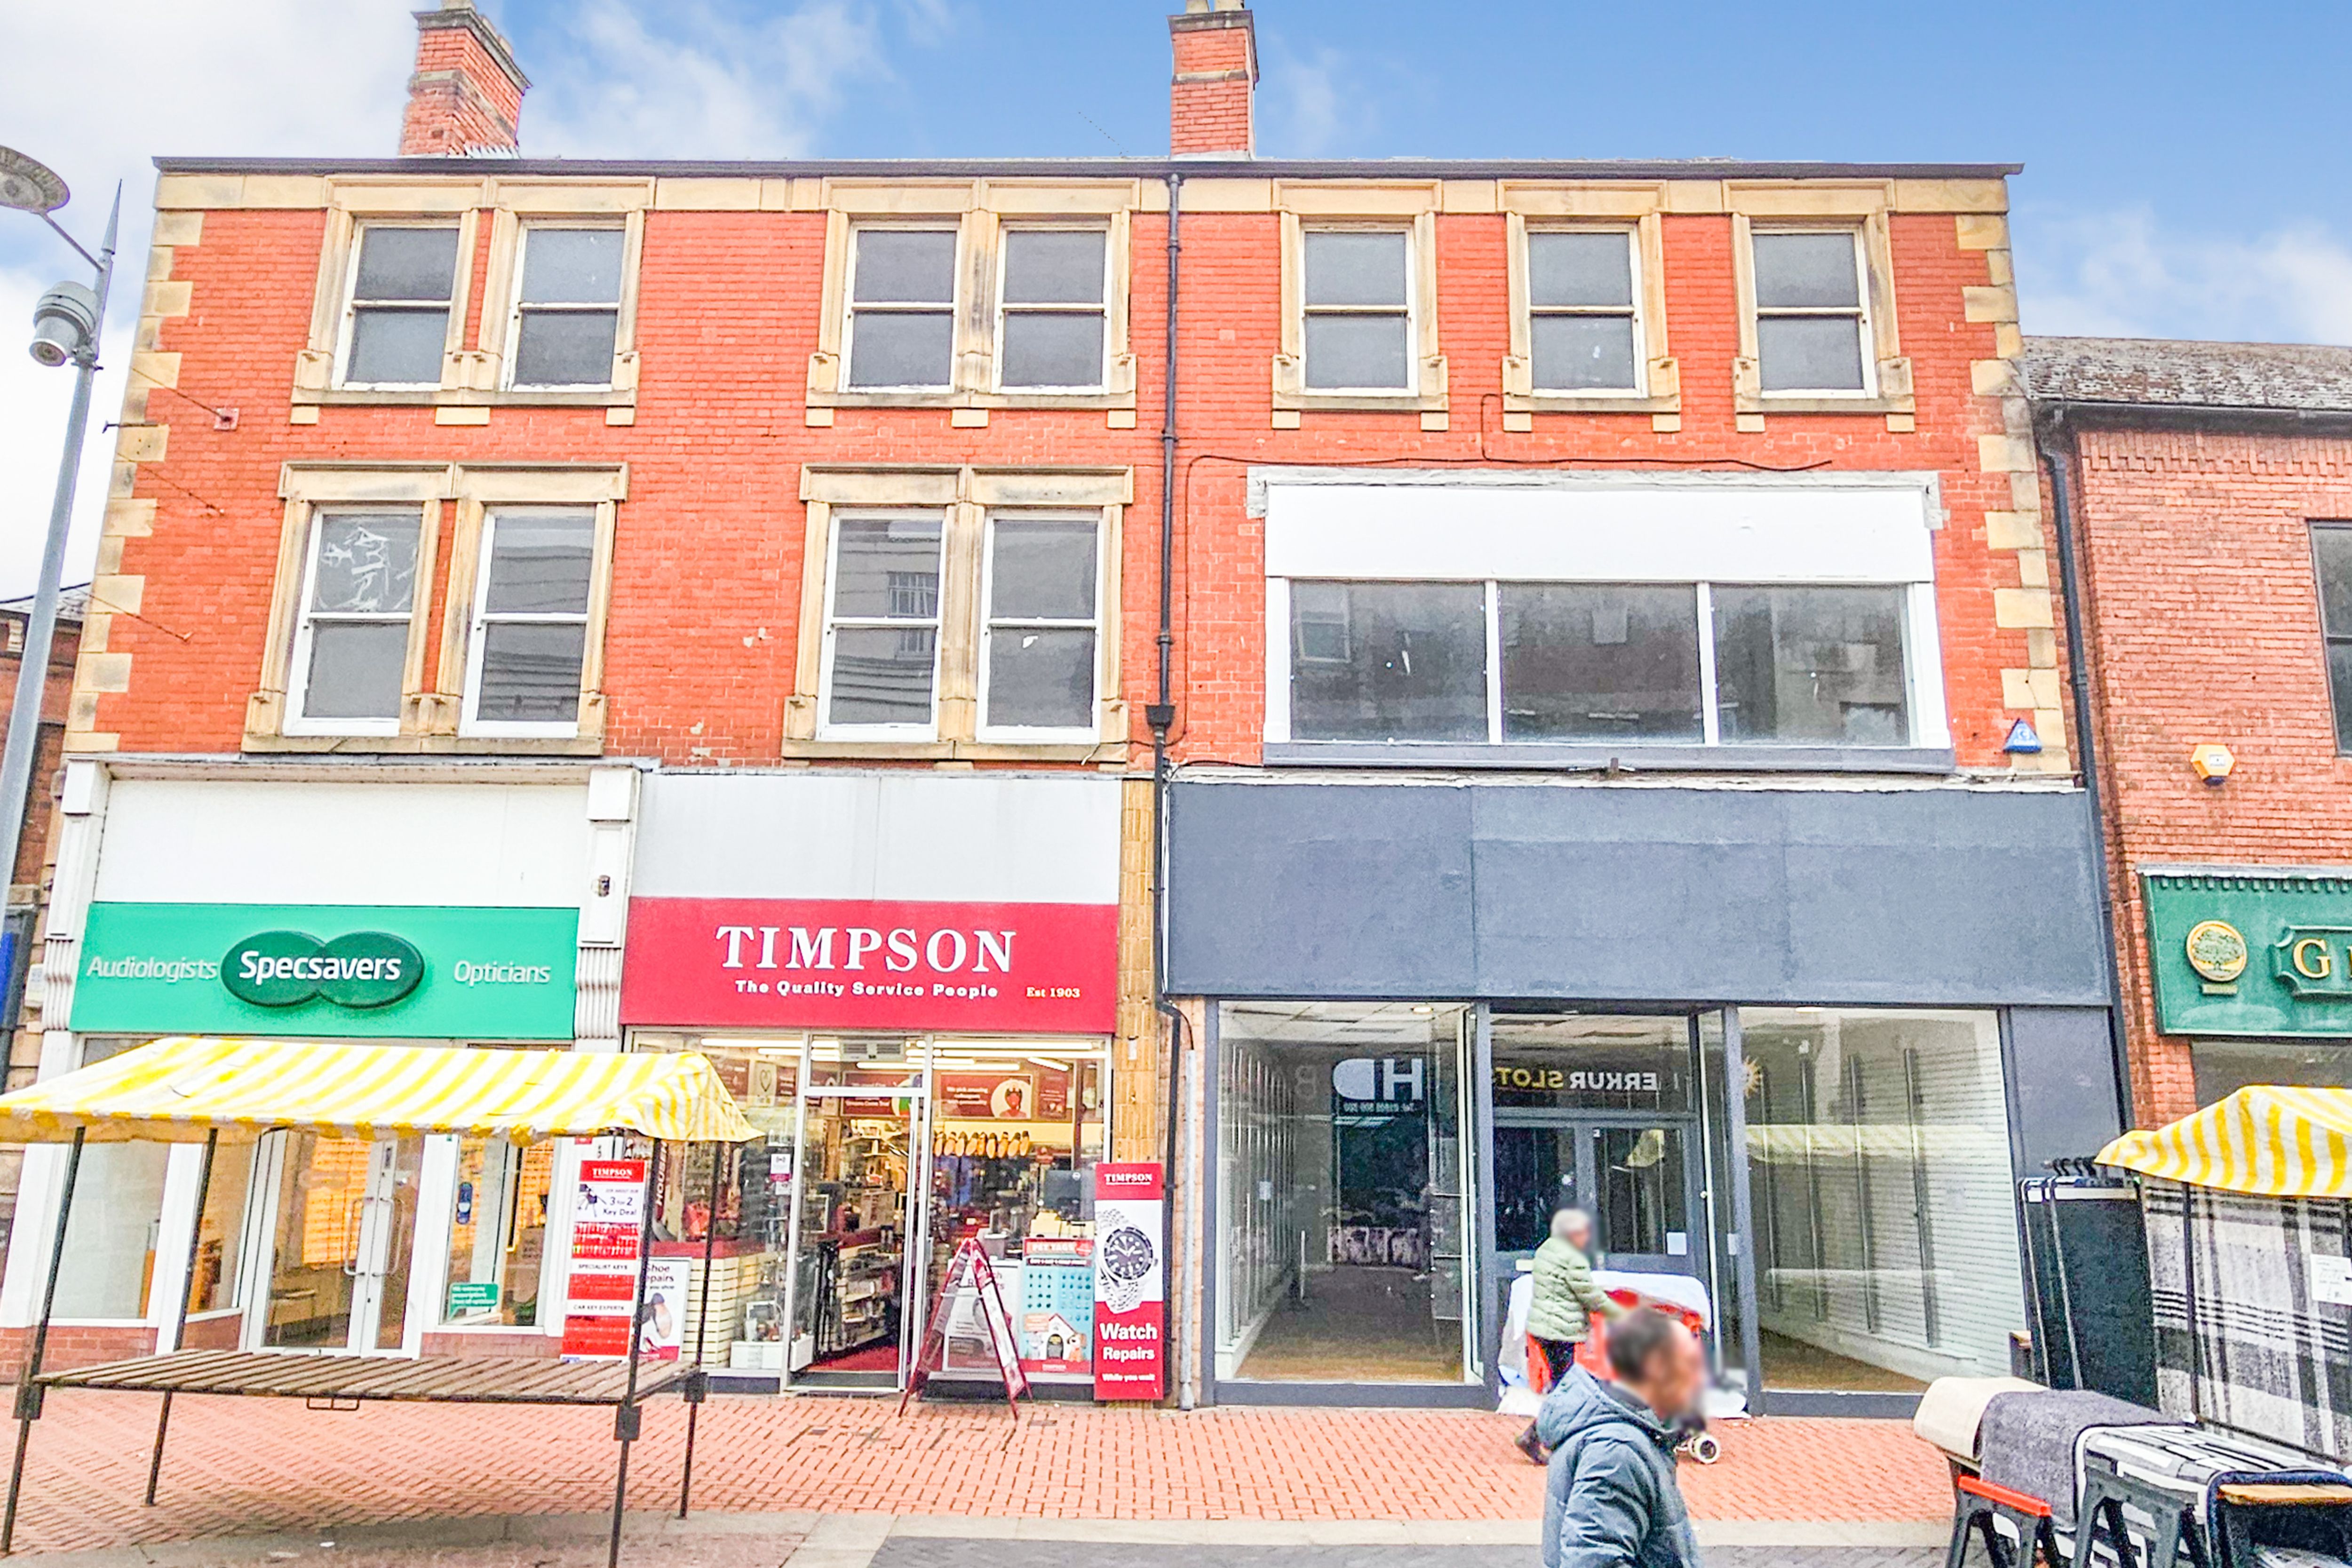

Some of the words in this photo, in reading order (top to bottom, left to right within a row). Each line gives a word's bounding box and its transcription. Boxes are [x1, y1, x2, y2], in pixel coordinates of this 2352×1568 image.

[715, 925, 1016, 973] TIMPSON
[2293, 938, 2352, 979] G
[87, 955, 218, 983] Audiologists
[239, 951, 401, 985] Specsavers
[453, 960, 551, 987] Opticians
[735, 980, 769, 994] The
[776, 979, 844, 998] Quality
[852, 981, 924, 996] Service
[932, 983, 998, 999] People
[1026, 986, 1046, 998] Est
[1049, 986, 1081, 999] 1903
[592, 1168, 632, 1176] TIMPSON
[1104, 1173, 1152, 1182] TIMPSON
[610, 1196, 615, 1206] 3
[627, 1197, 633, 1206] 2
[1100, 1323, 1158, 1341] Watch
[1103, 1346, 1155, 1363] Repairs
